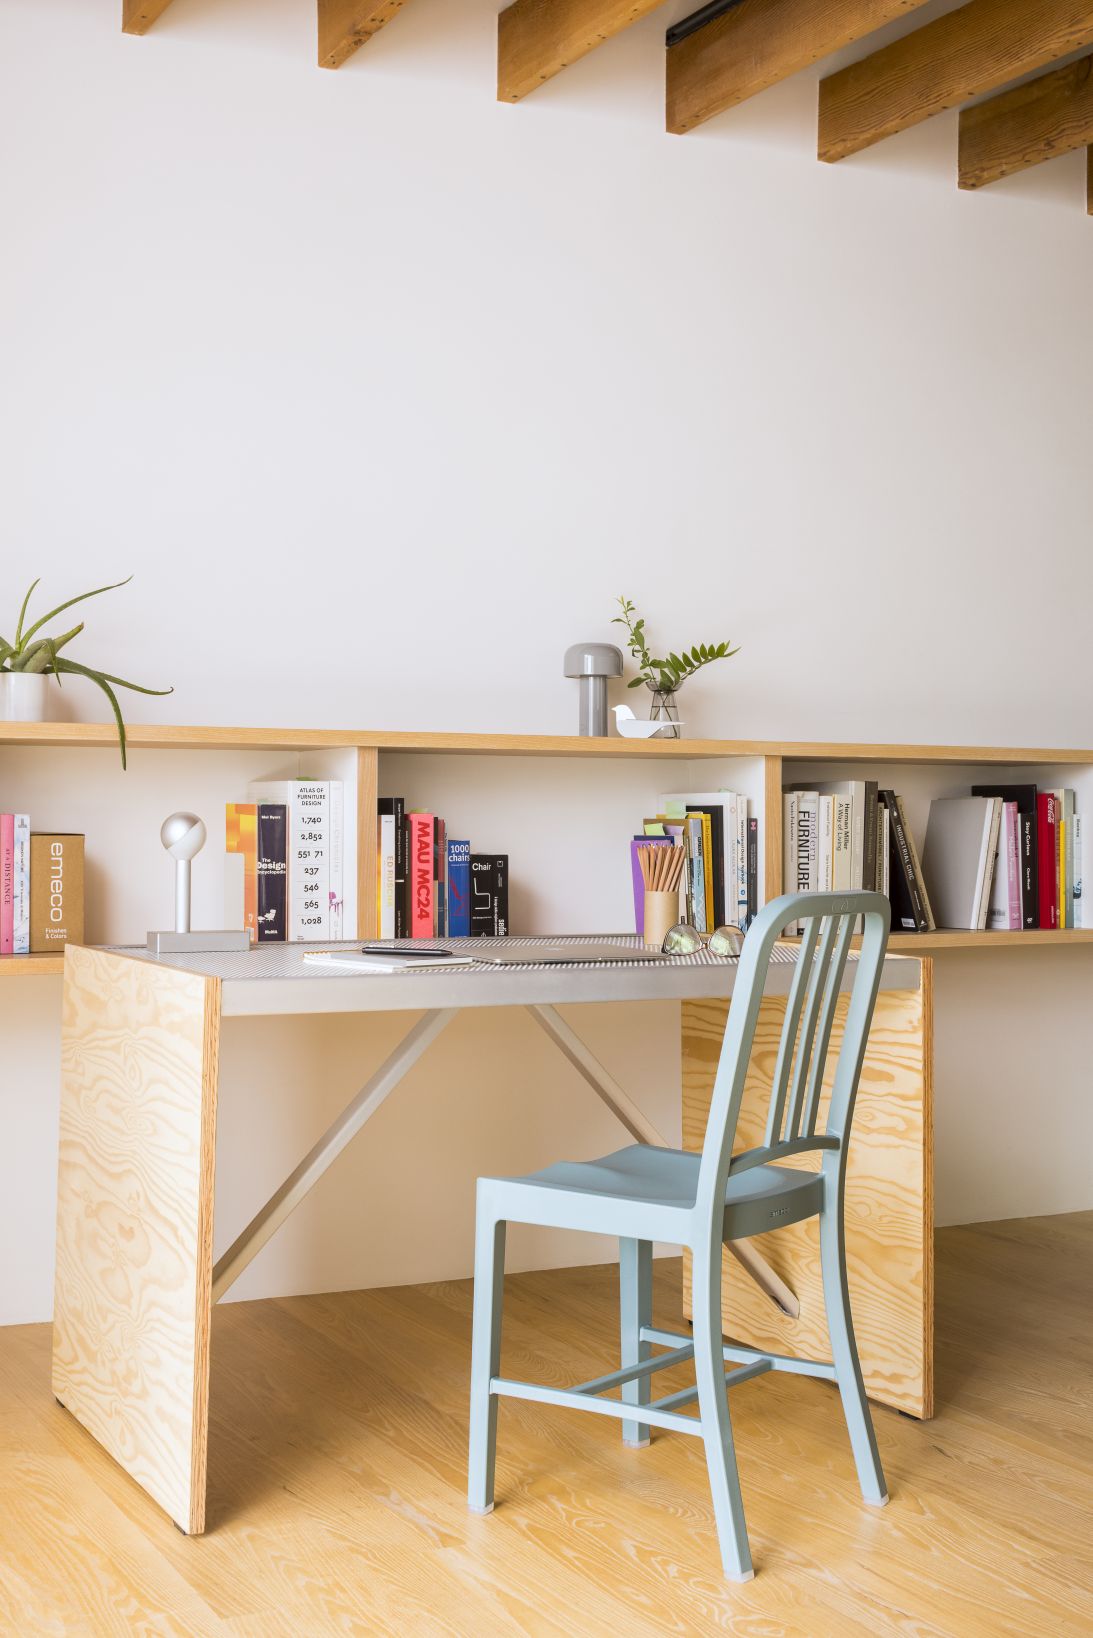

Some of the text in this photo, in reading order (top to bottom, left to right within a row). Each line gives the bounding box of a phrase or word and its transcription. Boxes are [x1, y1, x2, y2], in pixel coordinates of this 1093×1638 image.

[301, 816, 322, 824] 1,740
[836, 809, 844, 823] Way
[300, 832, 323, 841] 2,852
[809, 811, 817, 861] modern
[450, 844, 469, 853] 1000
[797, 810, 810, 890] FURNITURE
[896, 824, 909, 864] INDUSTRIAL
[905, 864, 915, 881] CHIC
[297, 850, 323, 859] 551 71
[448, 853, 470, 862] chairs
[387, 855, 394, 867] ED
[257, 861, 286, 871] Design
[417, 820, 431, 920] MAU MC24
[472, 863, 491, 871] Chair
[304, 867, 319, 875] 237
[50, 842, 63, 922] emeco
[303, 883, 319, 892] 546
[304, 900, 319, 909] 565
[300, 916, 322, 925] 1,028
[498, 918, 507, 936] sedie
